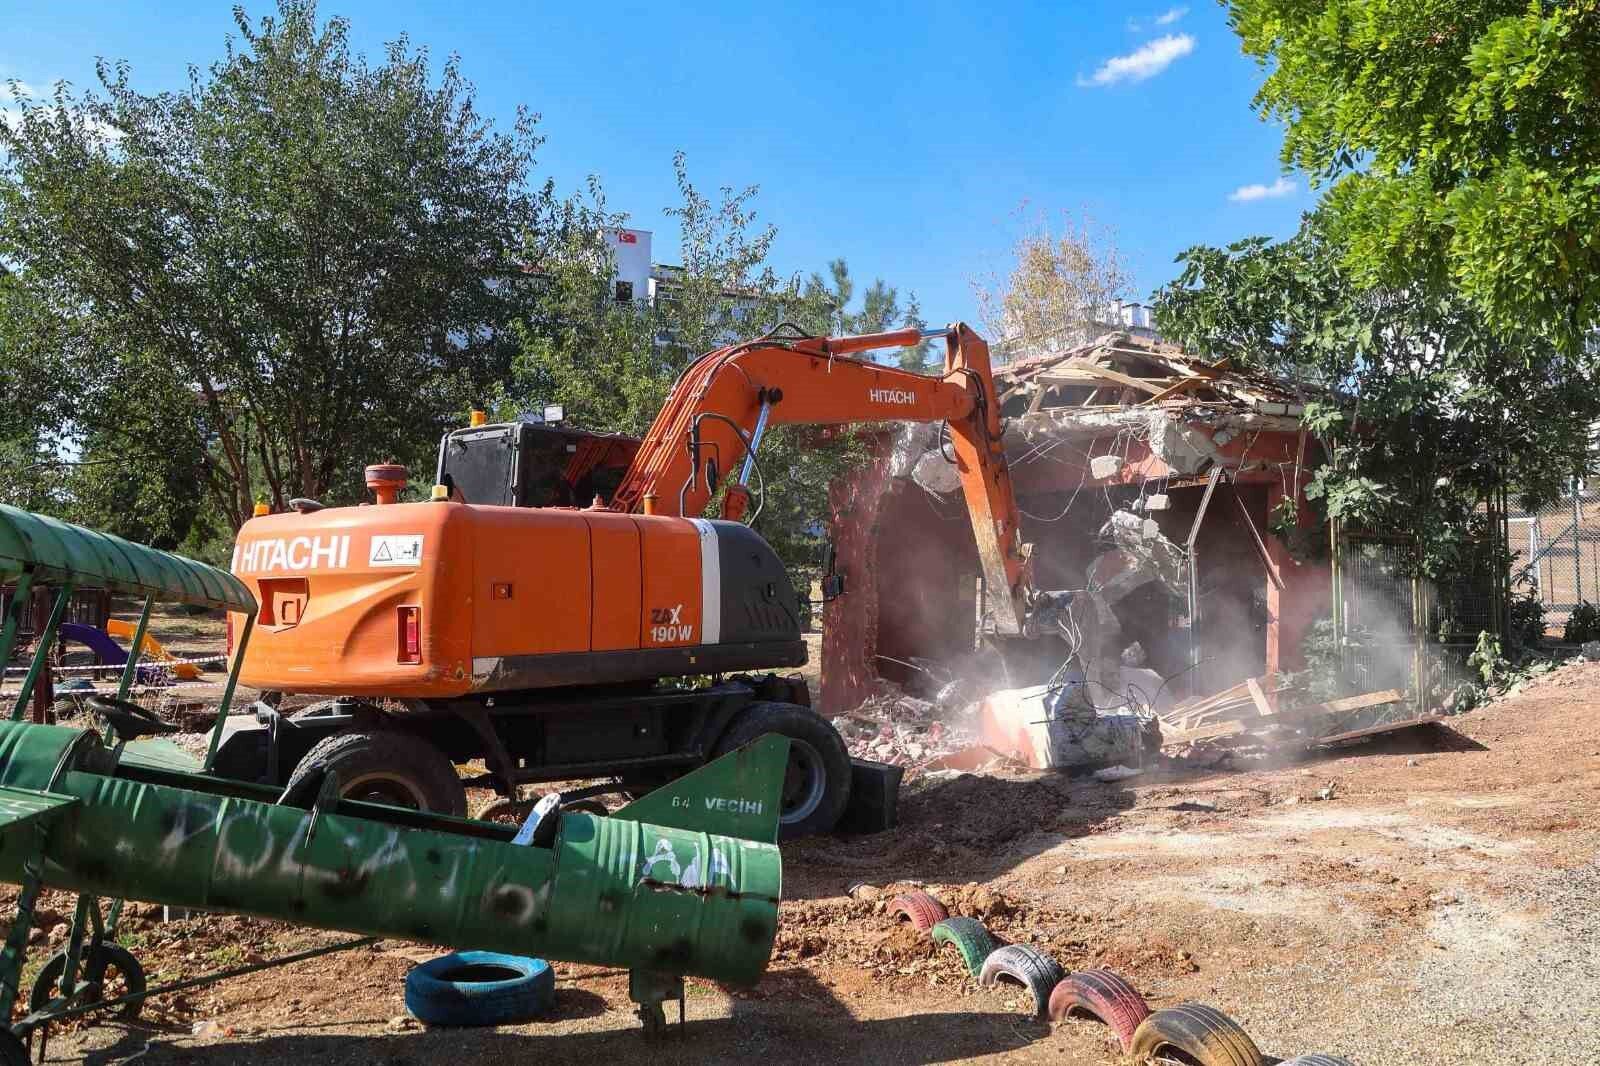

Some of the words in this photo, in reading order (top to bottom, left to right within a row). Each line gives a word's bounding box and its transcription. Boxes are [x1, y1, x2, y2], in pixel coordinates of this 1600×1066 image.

[869, 388, 915, 405] HITACHI
[240, 535, 350, 573] HITACHI
[651, 604, 683, 625] ZAX
